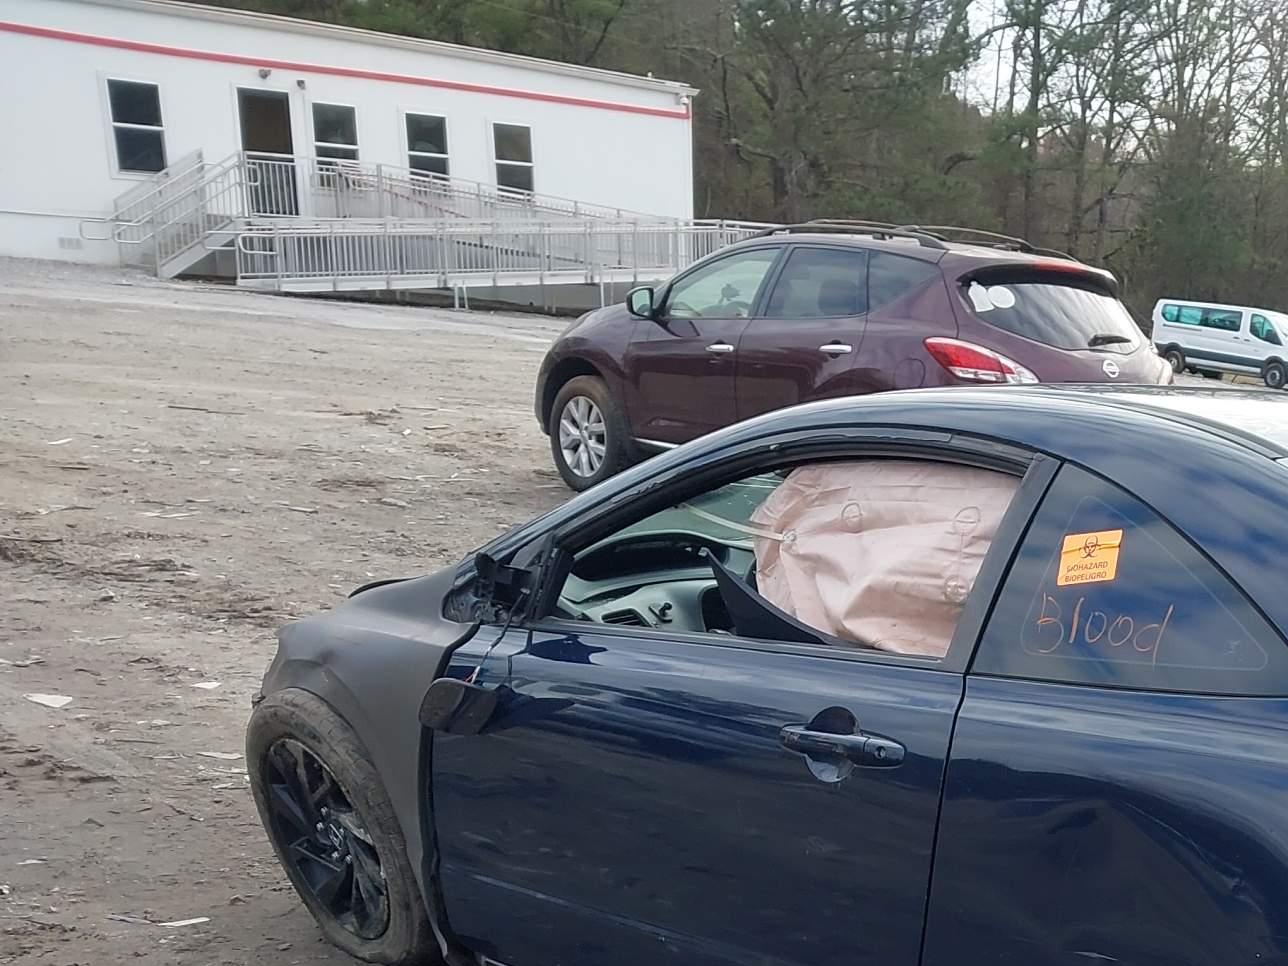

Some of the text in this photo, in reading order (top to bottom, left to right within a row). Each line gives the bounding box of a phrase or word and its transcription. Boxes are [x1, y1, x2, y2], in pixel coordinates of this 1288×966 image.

[1066, 560, 1109, 572] BIOHAZARD
[1064, 570, 1107, 583] BIOPELIGRO
[1036, 592, 1175, 665] Blood
